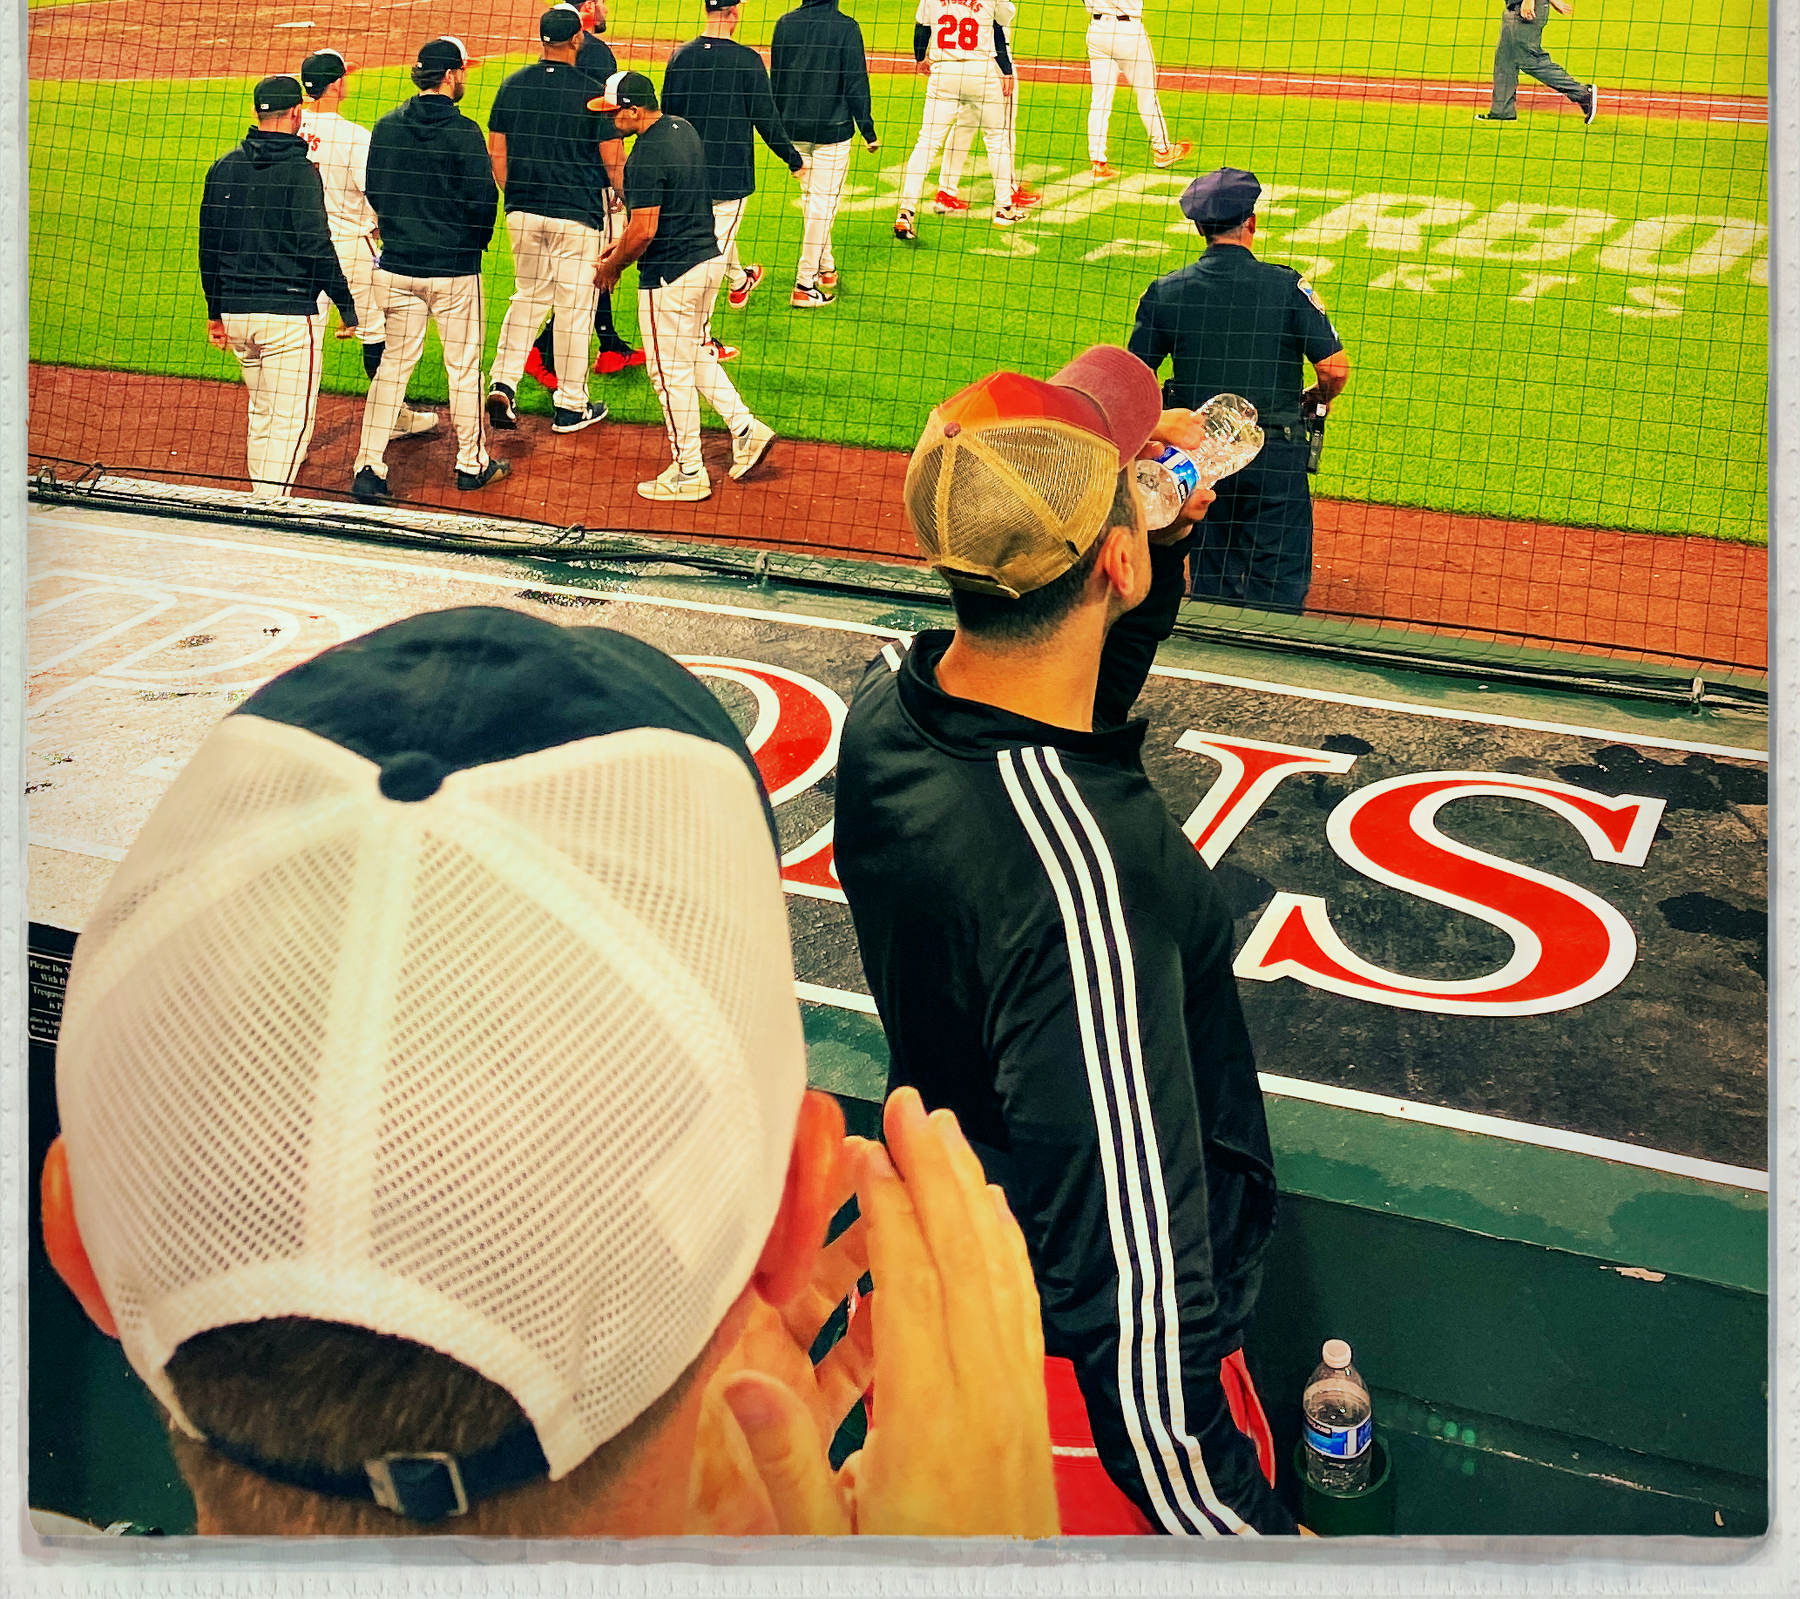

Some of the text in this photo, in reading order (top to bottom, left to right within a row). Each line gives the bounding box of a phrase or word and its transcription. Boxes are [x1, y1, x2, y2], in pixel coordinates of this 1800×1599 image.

[937, 14, 980, 51] 28
[30, 959, 51, 971] Please
[52, 963, 63, 974] Do
[41, 973, 58, 984] With
